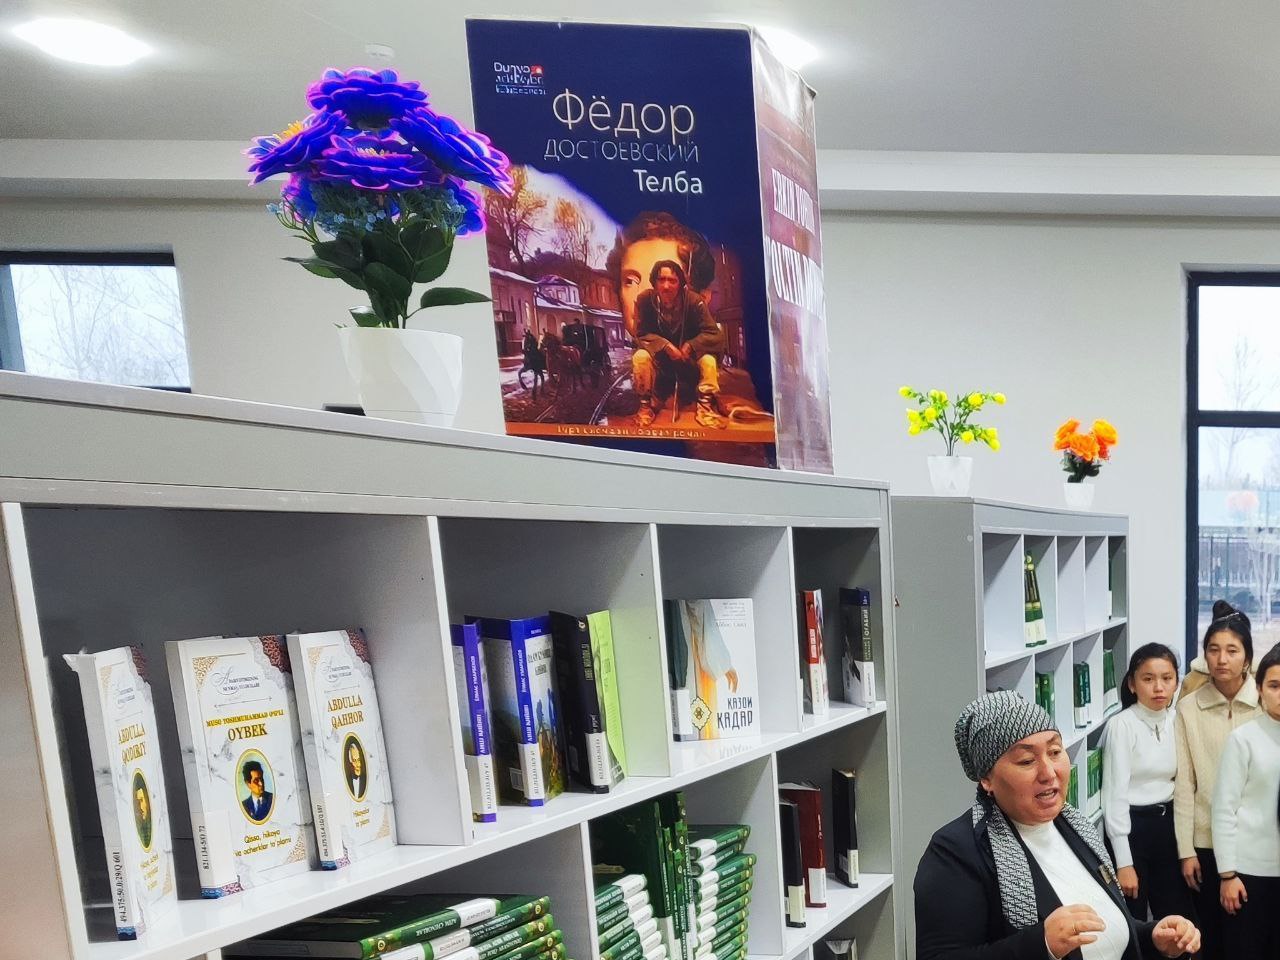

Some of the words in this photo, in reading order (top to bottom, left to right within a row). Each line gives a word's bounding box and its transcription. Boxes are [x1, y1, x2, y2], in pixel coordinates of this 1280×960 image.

[552, 88, 694, 145] Фёдор
[543, 138, 699, 163] ДОСТОЕВСКИЙ
[632, 168, 703, 194] Телба
[327, 694, 364, 712] ABDULLA
[331, 710, 364, 730] QAHHOR
[716, 710, 753, 731] ҚАДАР
[118, 722, 146, 745] ABDULLA
[227, 723, 268, 741] OYBEK
